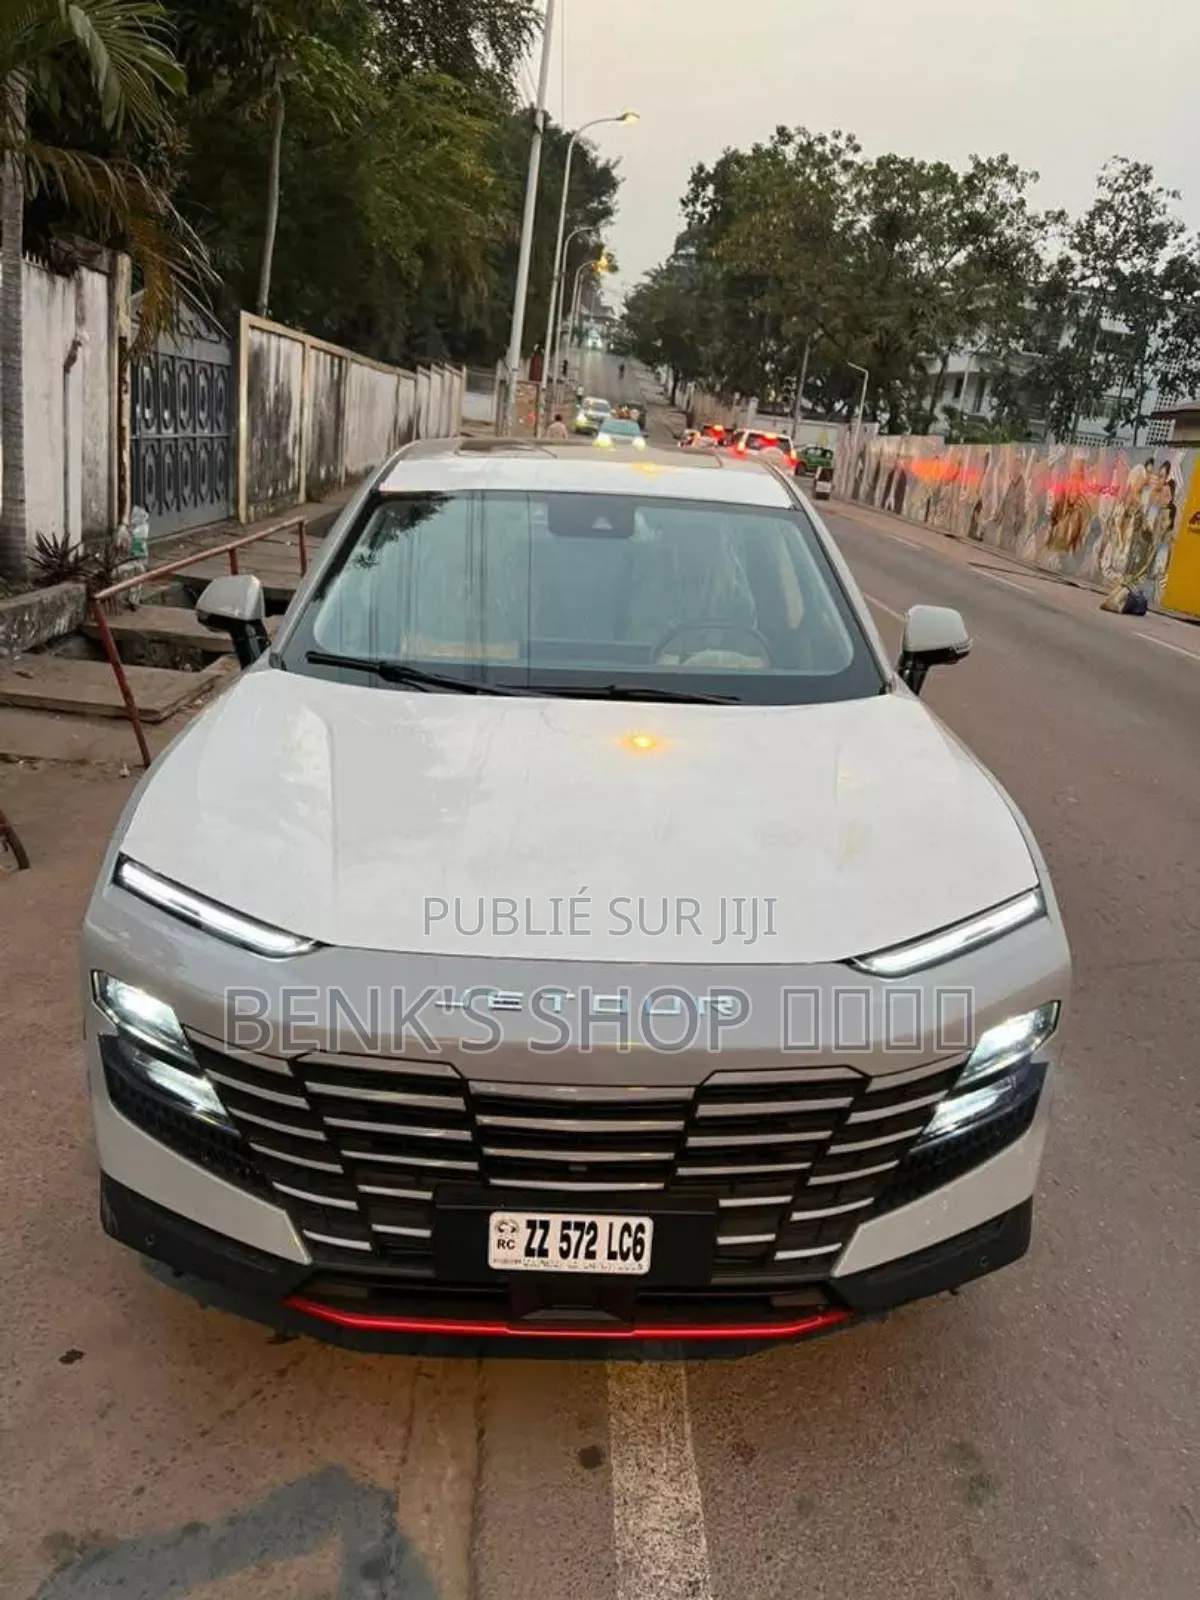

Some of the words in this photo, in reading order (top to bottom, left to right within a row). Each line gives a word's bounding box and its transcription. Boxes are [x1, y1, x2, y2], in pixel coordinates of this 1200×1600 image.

[497, 1239, 516, 1250] RC
[524, 1219, 551, 1258] ZZ
[558, 1220, 599, 1260] 572
[606, 1221, 646, 1262] LC6
